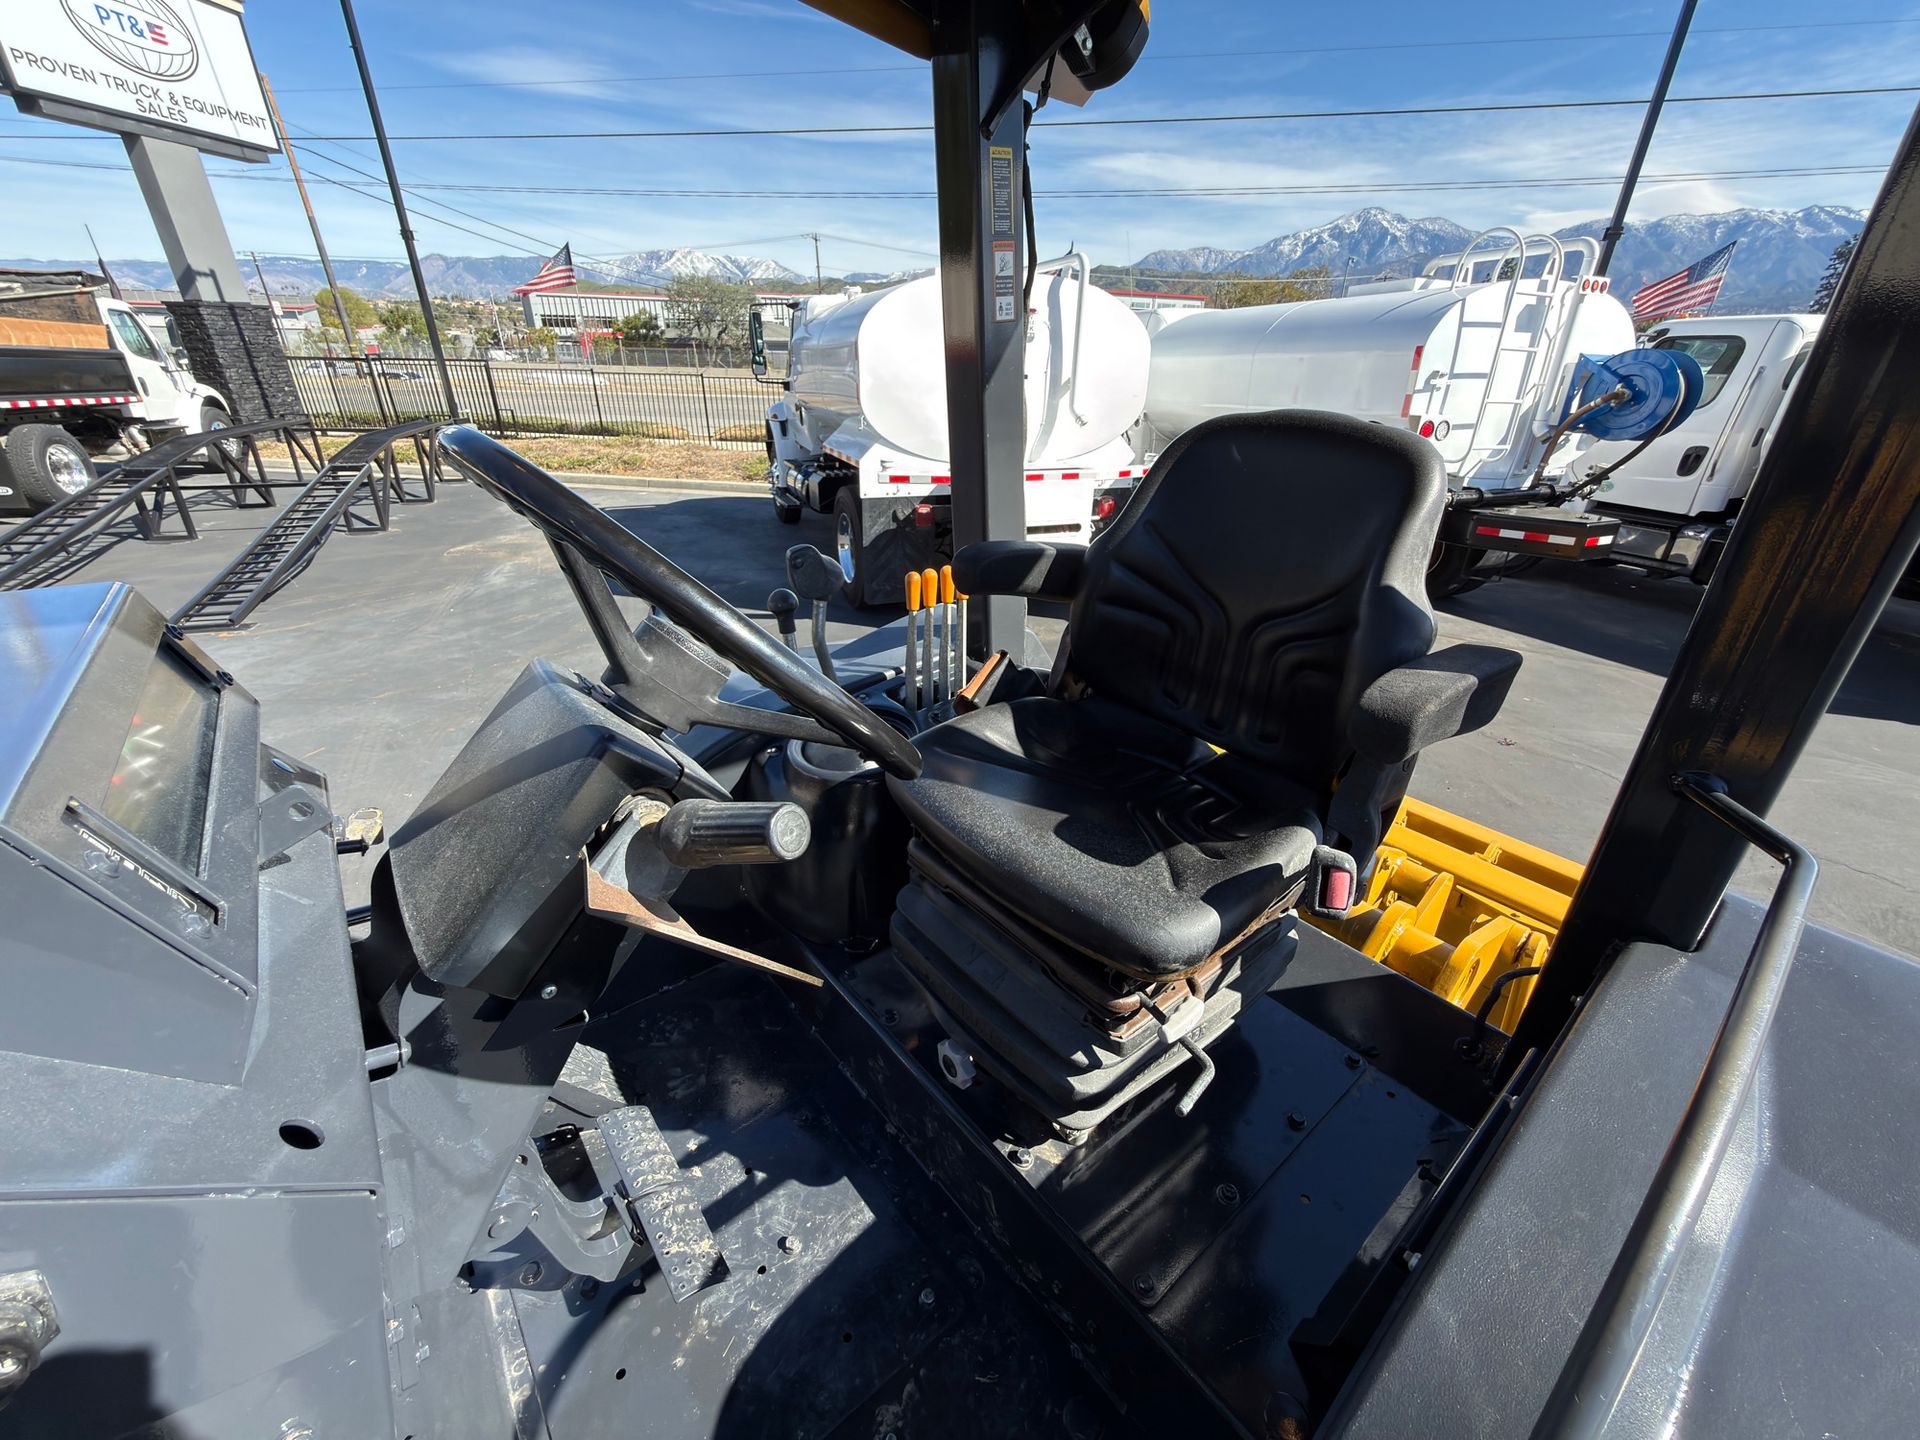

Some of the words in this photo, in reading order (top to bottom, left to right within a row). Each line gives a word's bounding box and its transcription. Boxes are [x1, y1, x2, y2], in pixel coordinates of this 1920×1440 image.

[10, 46, 98, 85] PROVEN
[99, 72, 164, 103] TRUCK
[168, 91, 180, 106] &
[182, 96, 267, 130] EQUIPMENT
[135, 98, 189, 124] SALES
